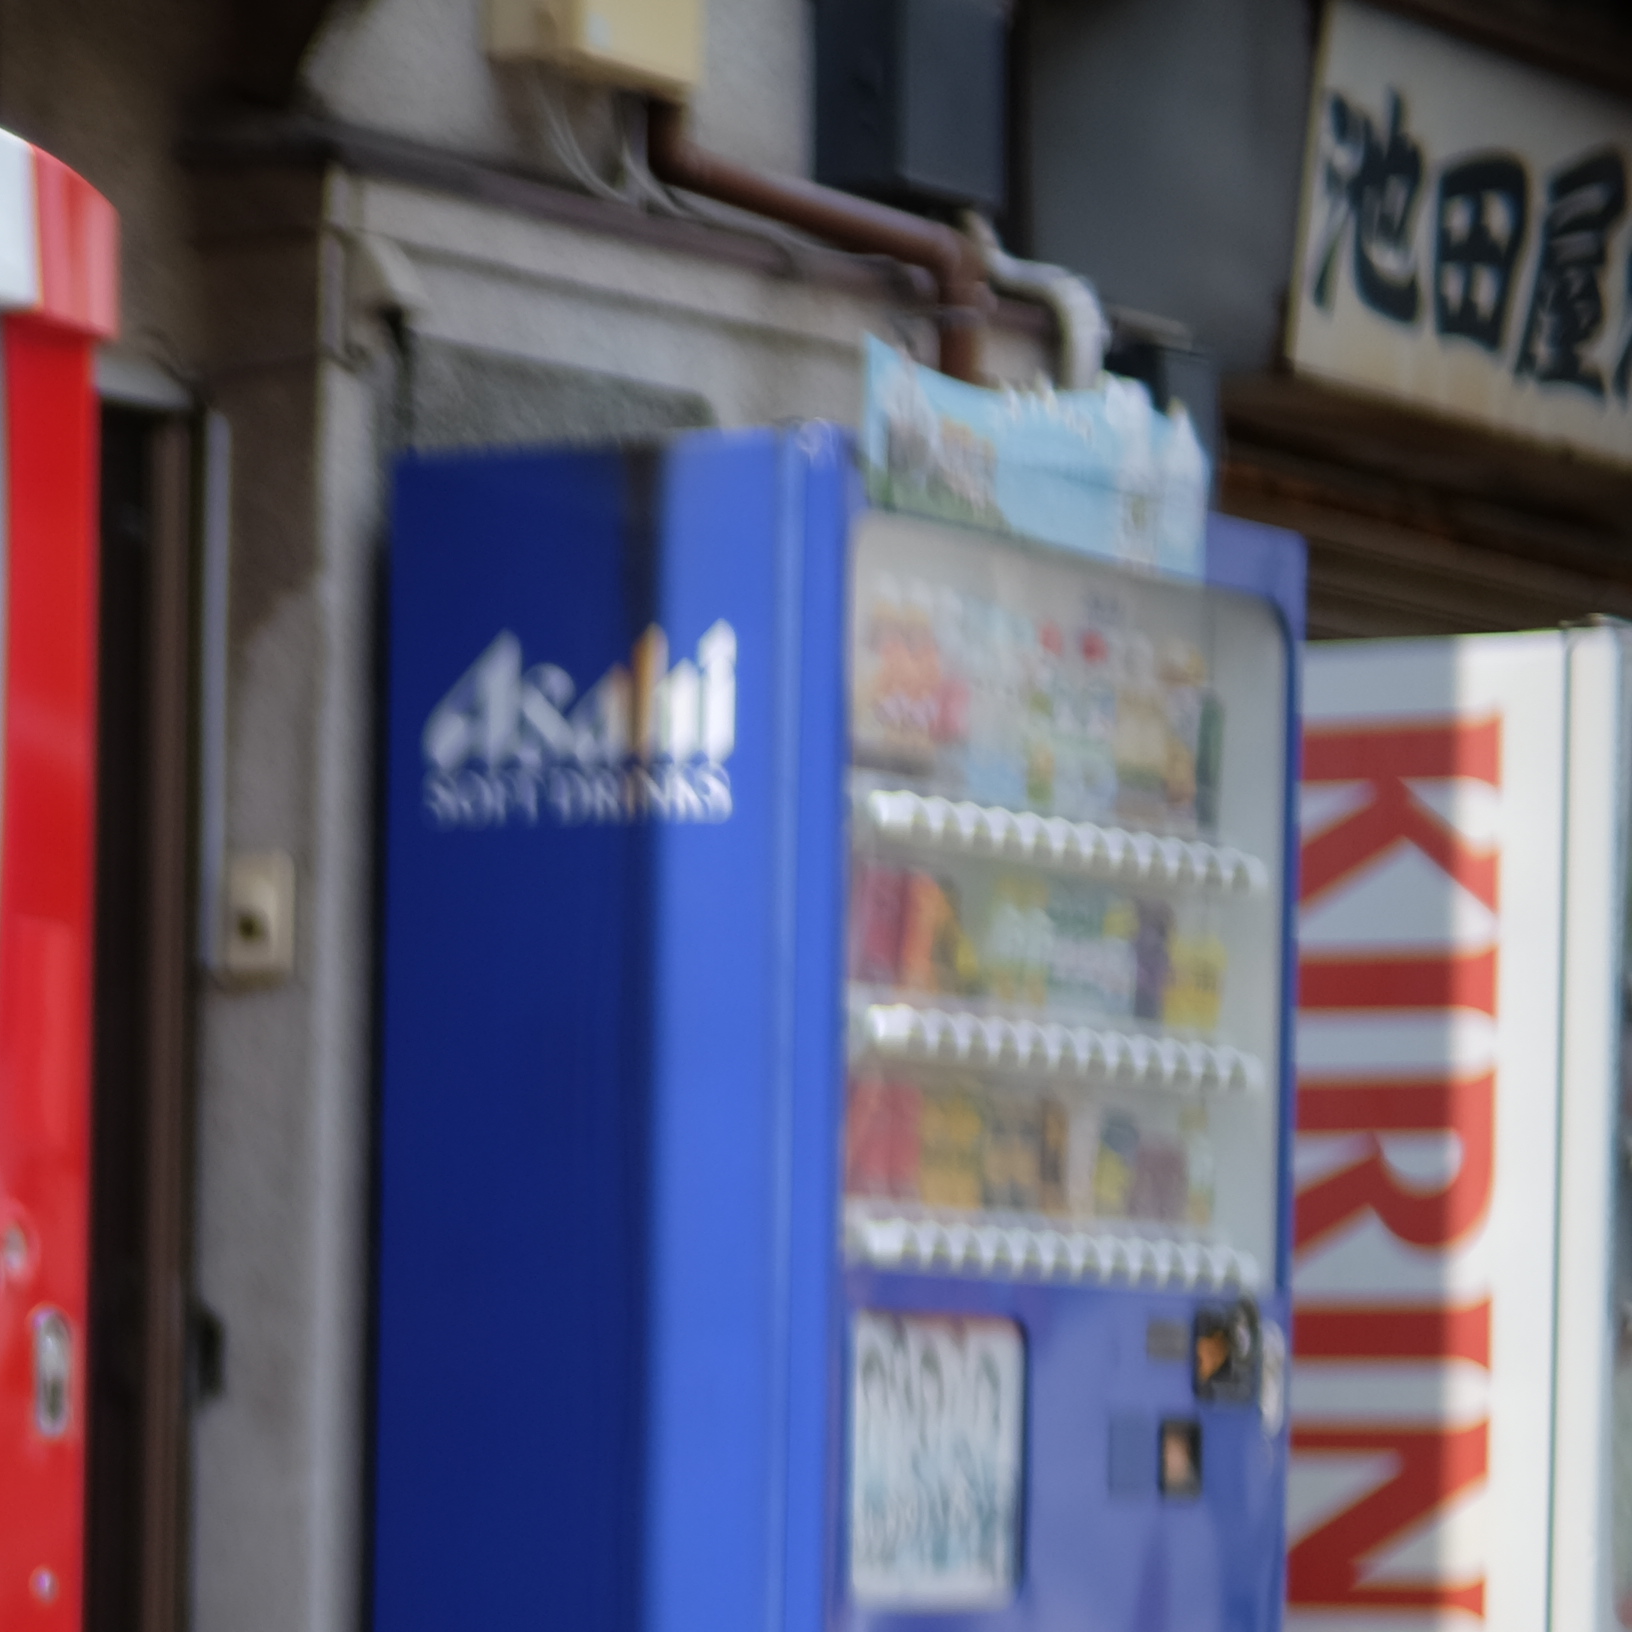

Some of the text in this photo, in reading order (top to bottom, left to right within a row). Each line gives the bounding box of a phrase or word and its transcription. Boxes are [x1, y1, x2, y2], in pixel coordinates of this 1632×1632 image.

[1313, 84, 1632, 410] 池田屋
[421, 620, 737, 770] Asahi
